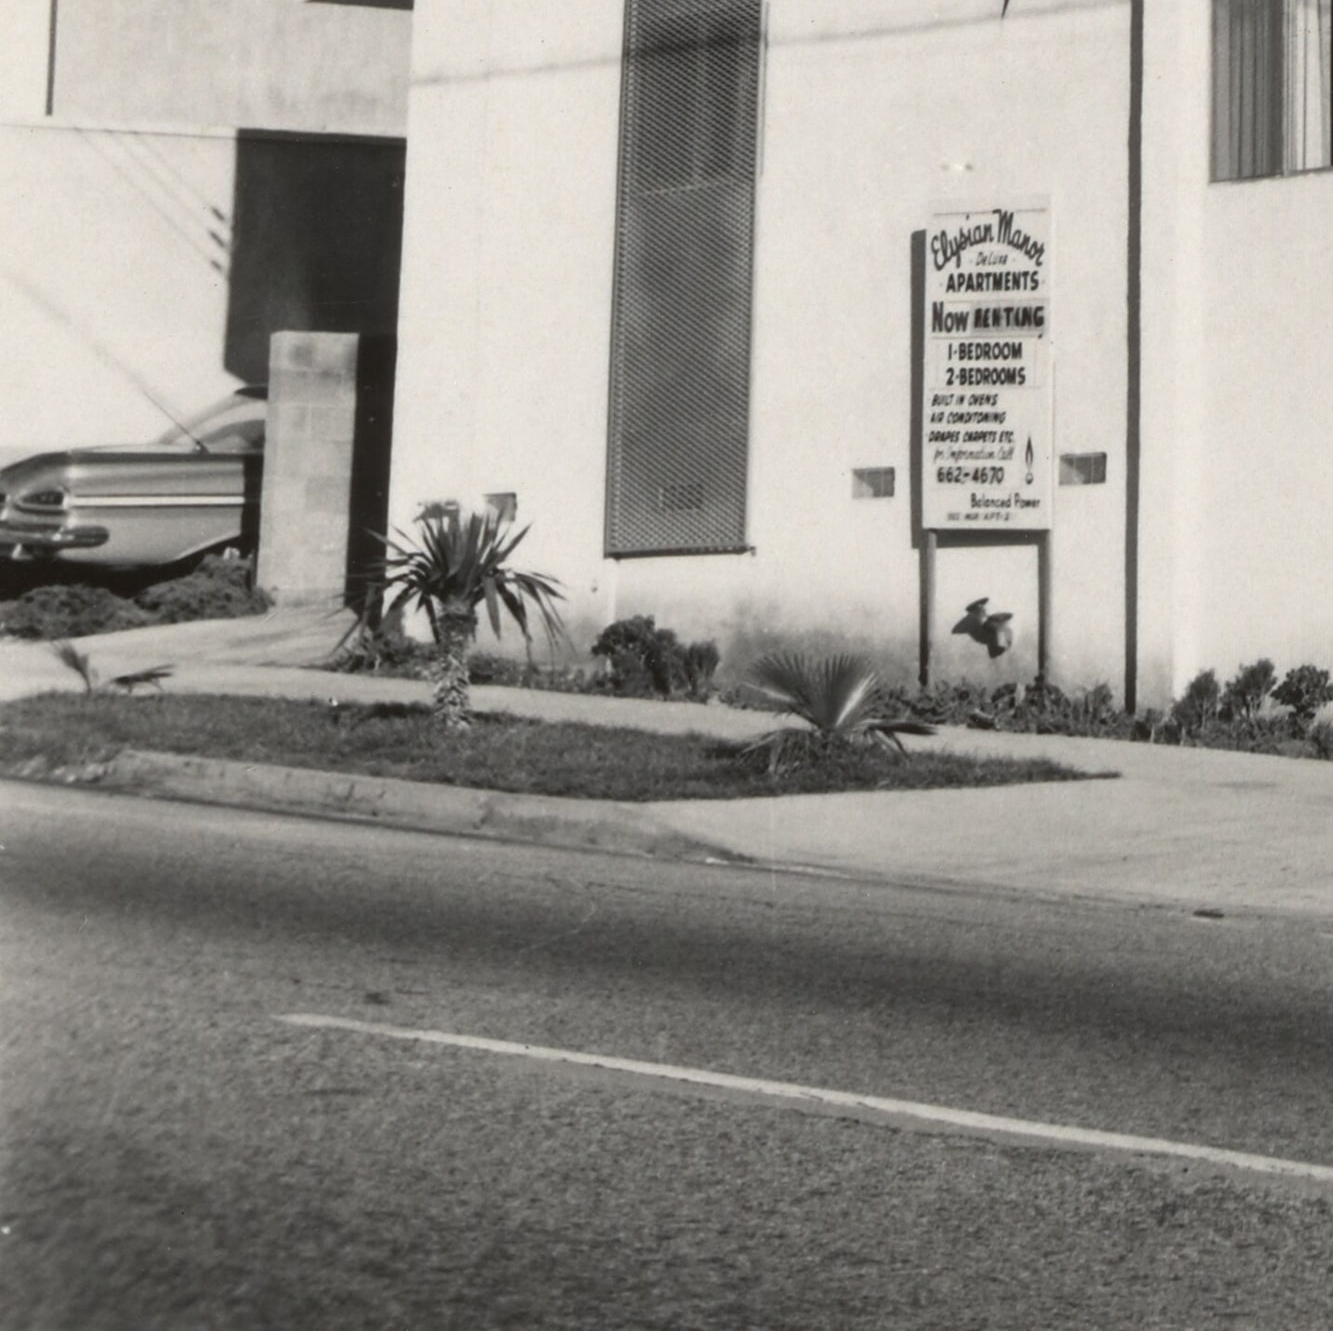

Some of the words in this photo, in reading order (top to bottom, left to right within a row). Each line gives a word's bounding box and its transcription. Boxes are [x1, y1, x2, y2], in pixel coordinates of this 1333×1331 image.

[930, 214, 994, 271] Elysian
[992, 208, 1045, 266] Manor
[945, 271, 1039, 293] APARTMENTS
[974, 306, 1044, 328] RENTING
[948, 342, 1022, 360] 1-BEDROOM
[946, 367, 1026, 386] 2-BEDROOMS
[968, 393, 998, 407] OVENS
[937, 466, 1005, 484] 662-4670
[971, 492, 1012, 509] Balanced
[1014, 492, 1040, 509] Power
